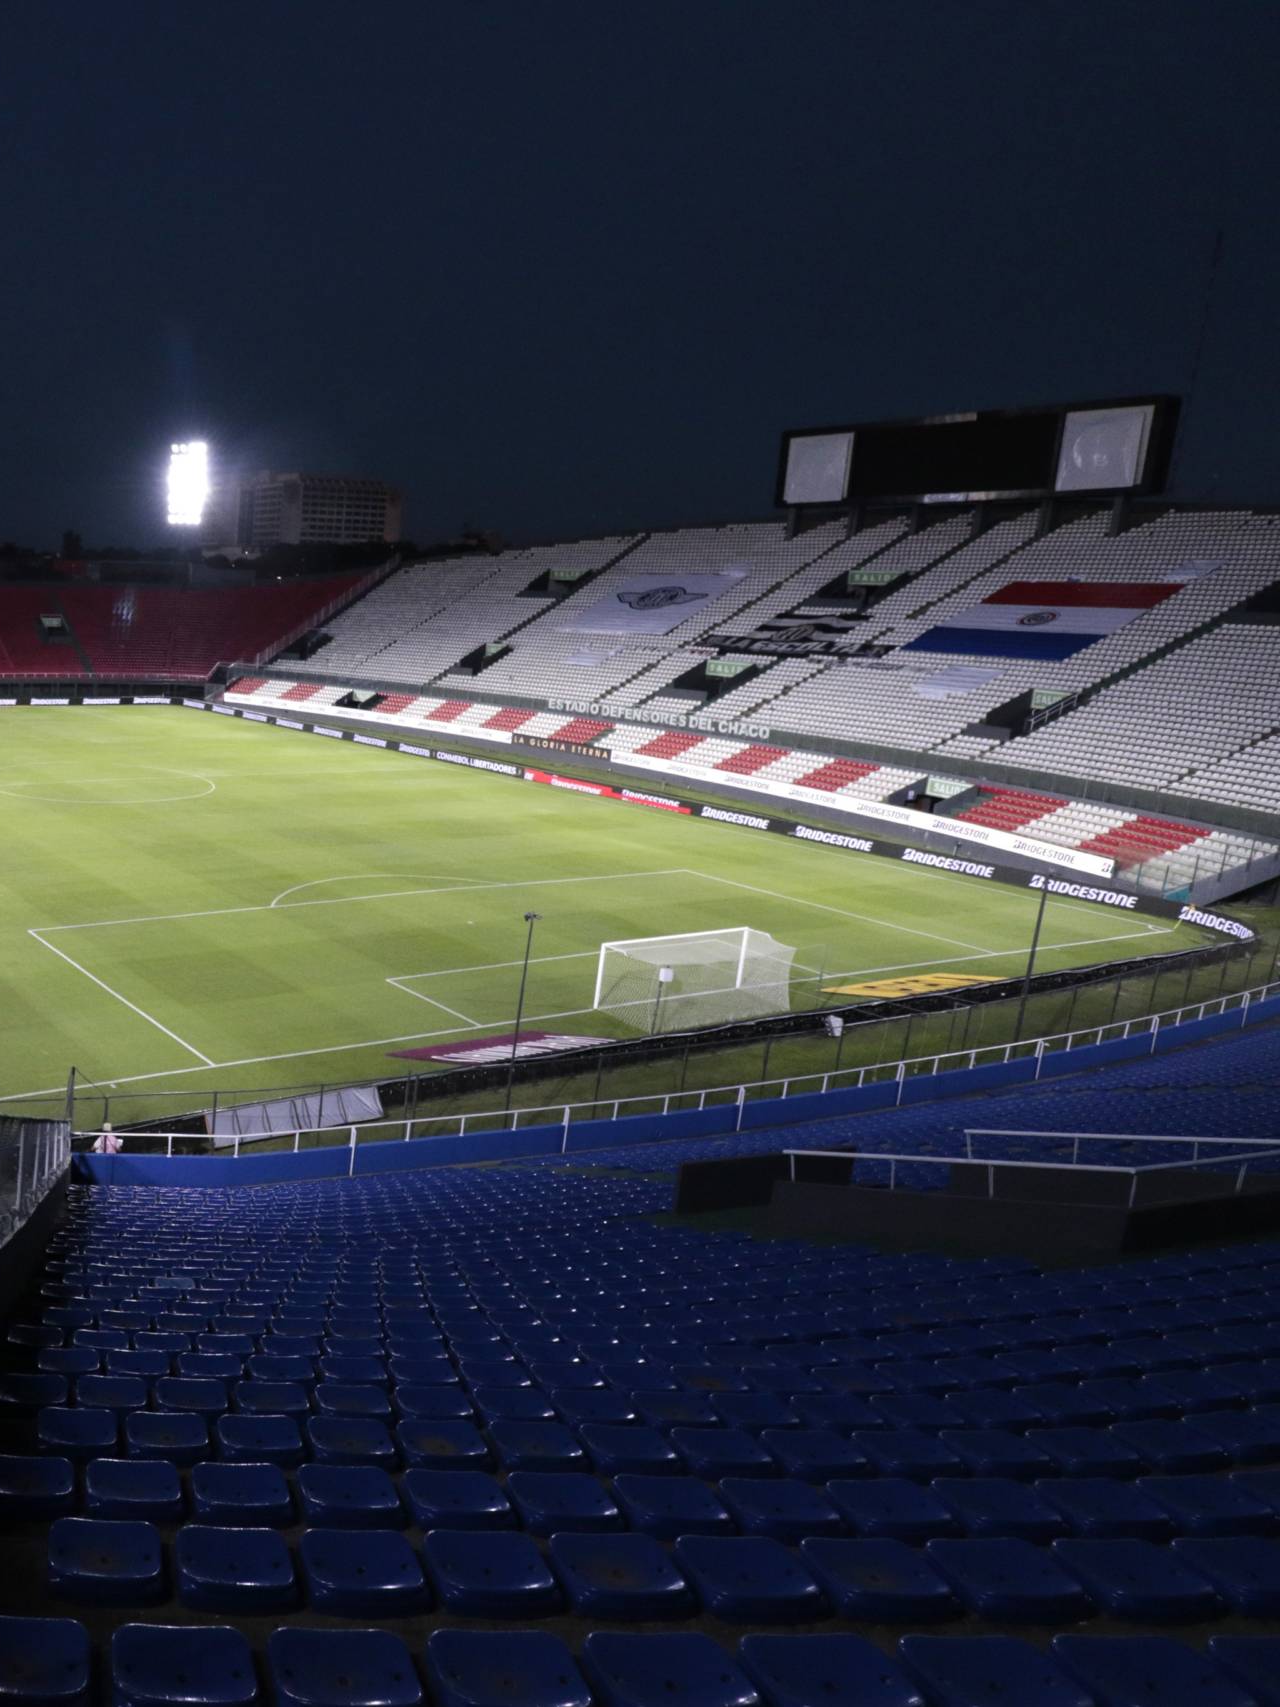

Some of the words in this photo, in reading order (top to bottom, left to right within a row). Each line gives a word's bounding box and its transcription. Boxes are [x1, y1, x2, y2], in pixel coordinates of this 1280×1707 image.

[548, 700, 600, 715] ESTADIO
[602, 706, 687, 728] DEFENSORES
[689, 718, 715, 732] DEL
[718, 719, 770, 739] CHACO
[514, 736, 524, 744] LA
[529, 738, 566, 751] GLORIA
[571, 745, 609, 759] ETERNA
[436, 751, 469, 765] CONMEBOL
[470, 758, 517, 775] LIBERTADORES
[701, 806, 770, 830] BRIDGESTONE
[857, 802, 911, 822] BRIDGESTONE
[795, 825, 874, 852] BRIDGESTONE
[933, 818, 990, 841] BRIDGESTONE
[902, 848, 995, 878] BRIDGESTONE
[1013, 839, 1075, 864] BRIDGESTONE
[1029, 873, 1139, 909] BRIDGESTONE
